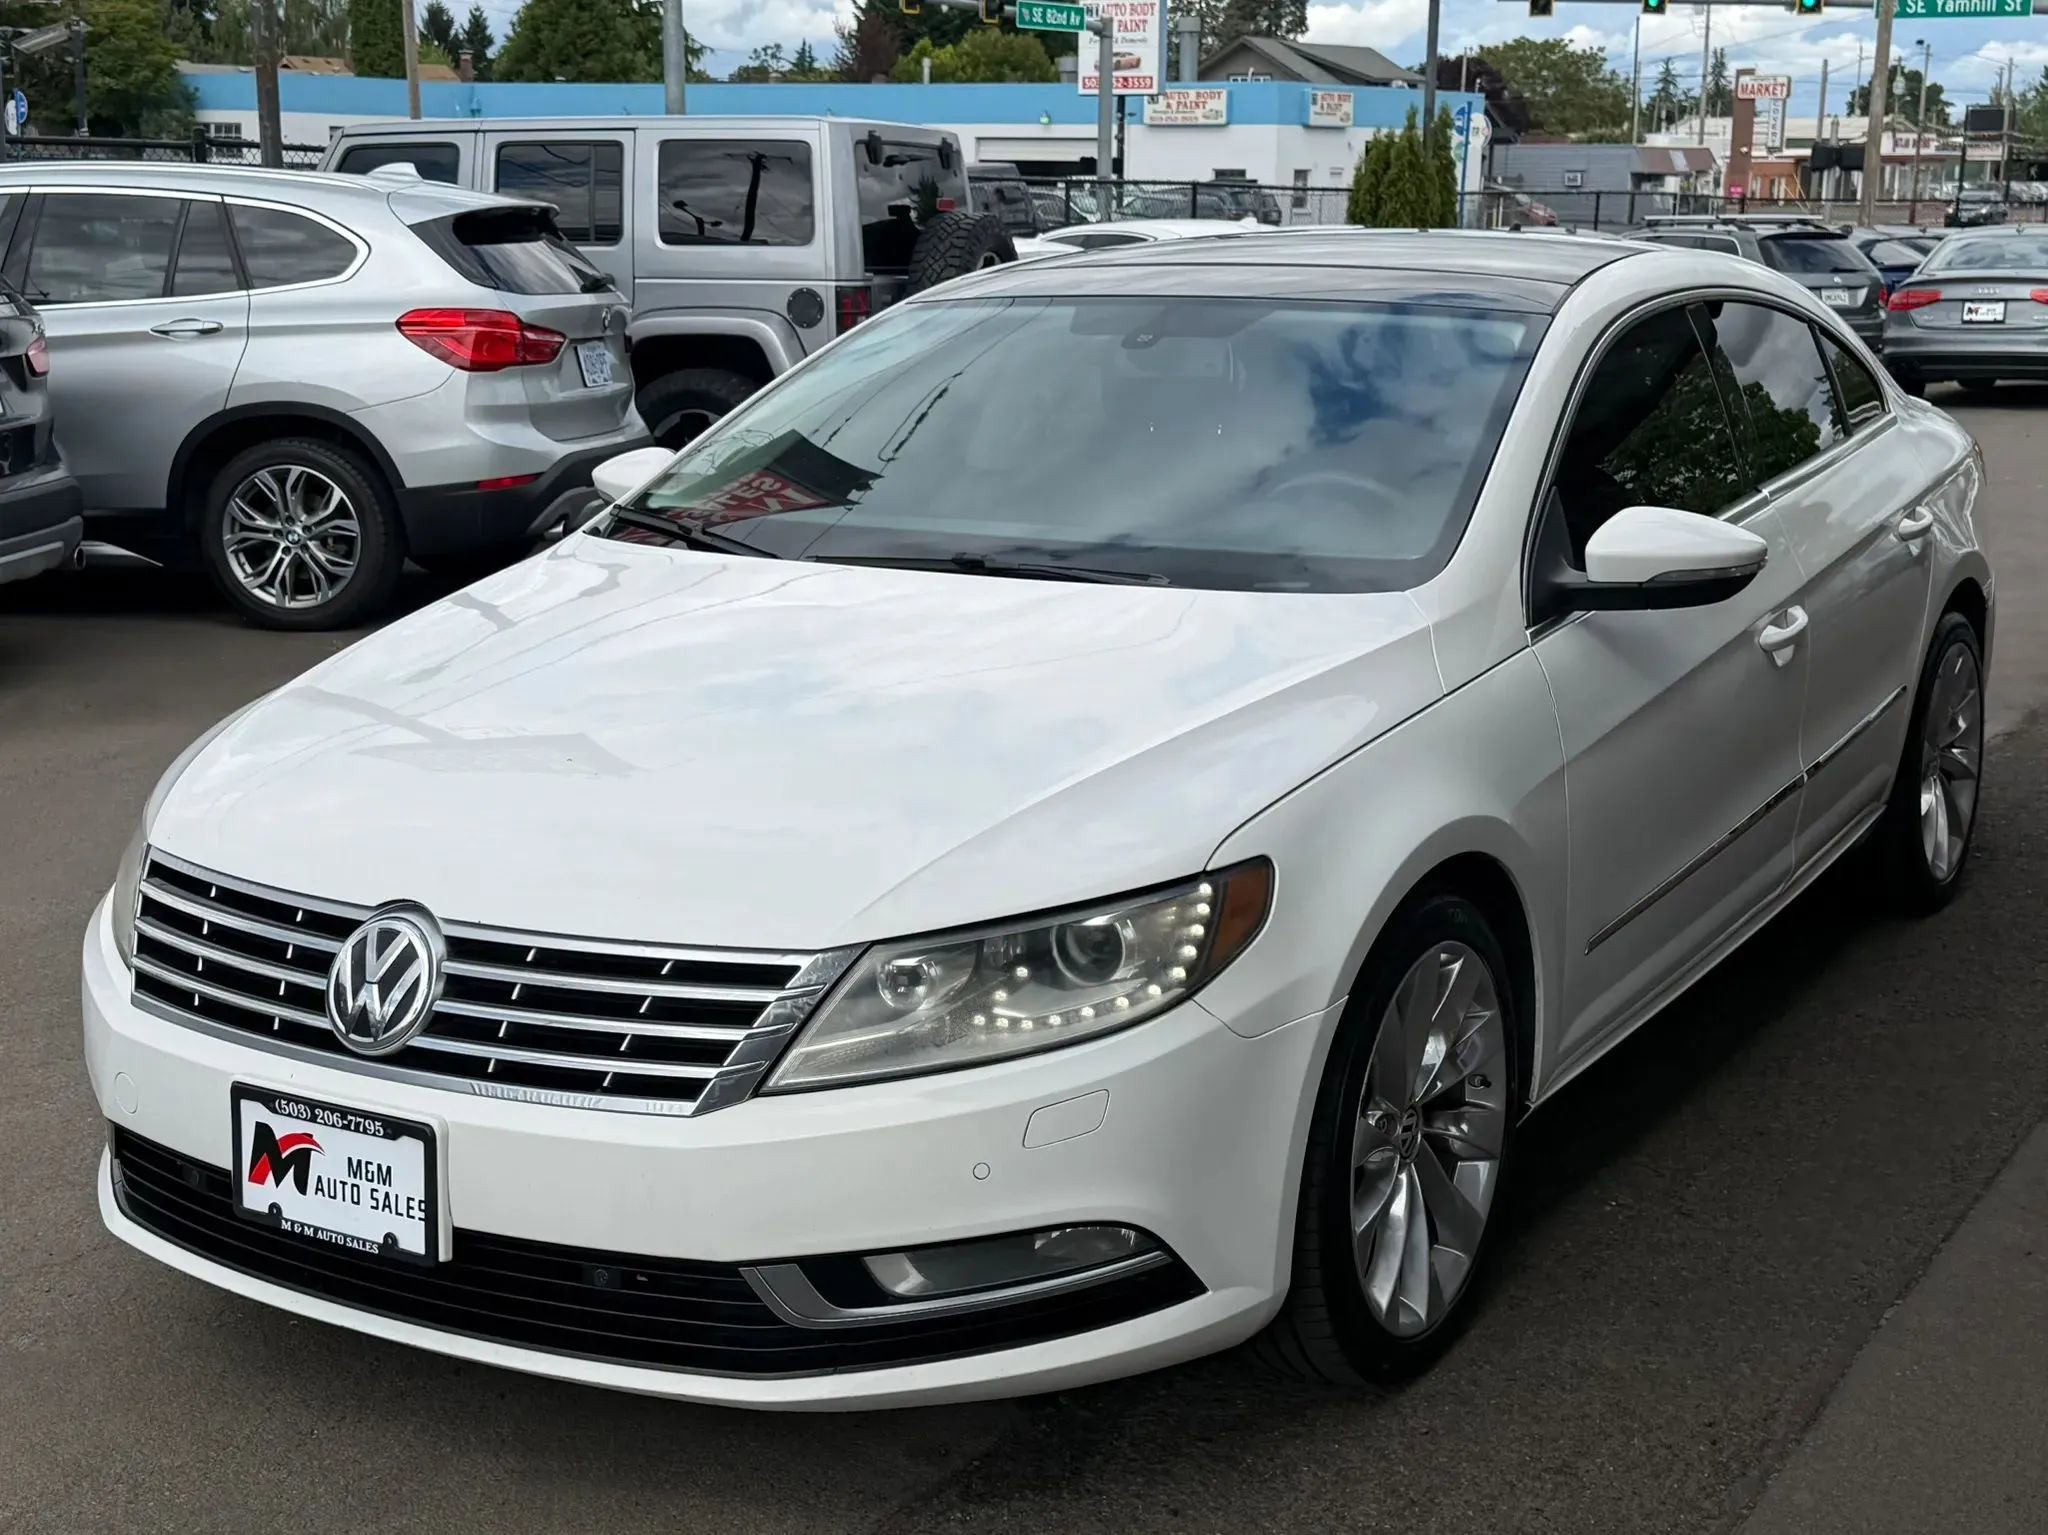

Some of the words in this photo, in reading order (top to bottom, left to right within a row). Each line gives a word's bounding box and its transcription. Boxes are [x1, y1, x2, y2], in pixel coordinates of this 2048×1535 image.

[1032, 7, 1043, 24] SE
[1045, 8, 1068, 26] 82nd
[1069, 10, 1081, 27] Av
[1102, 3, 1126, 17] AUTO
[1129, 2, 1156, 16] BODY
[1906, 0, 1926, 14] SE
[1936, 0, 1996, 13] Yamhill
[2004, 0, 2022, 12] St
[1117, 19, 1149, 33] PAINT
[1741, 82, 1785, 97] MARKET
[275, 1099, 311, 1120] (503)
[314, 1108, 384, 1136] 206-7795
[347, 1156, 392, 1188] M&M
[314, 1174, 361, 1206] AUTO
[370, 1187, 426, 1222] SALES
[281, 1219, 292, 1231] M
[293, 1223, 303, 1233] &
[303, 1225, 315, 1237] M
[316, 1229, 345, 1245] AUTO
[345, 1236, 379, 1254] SALES
